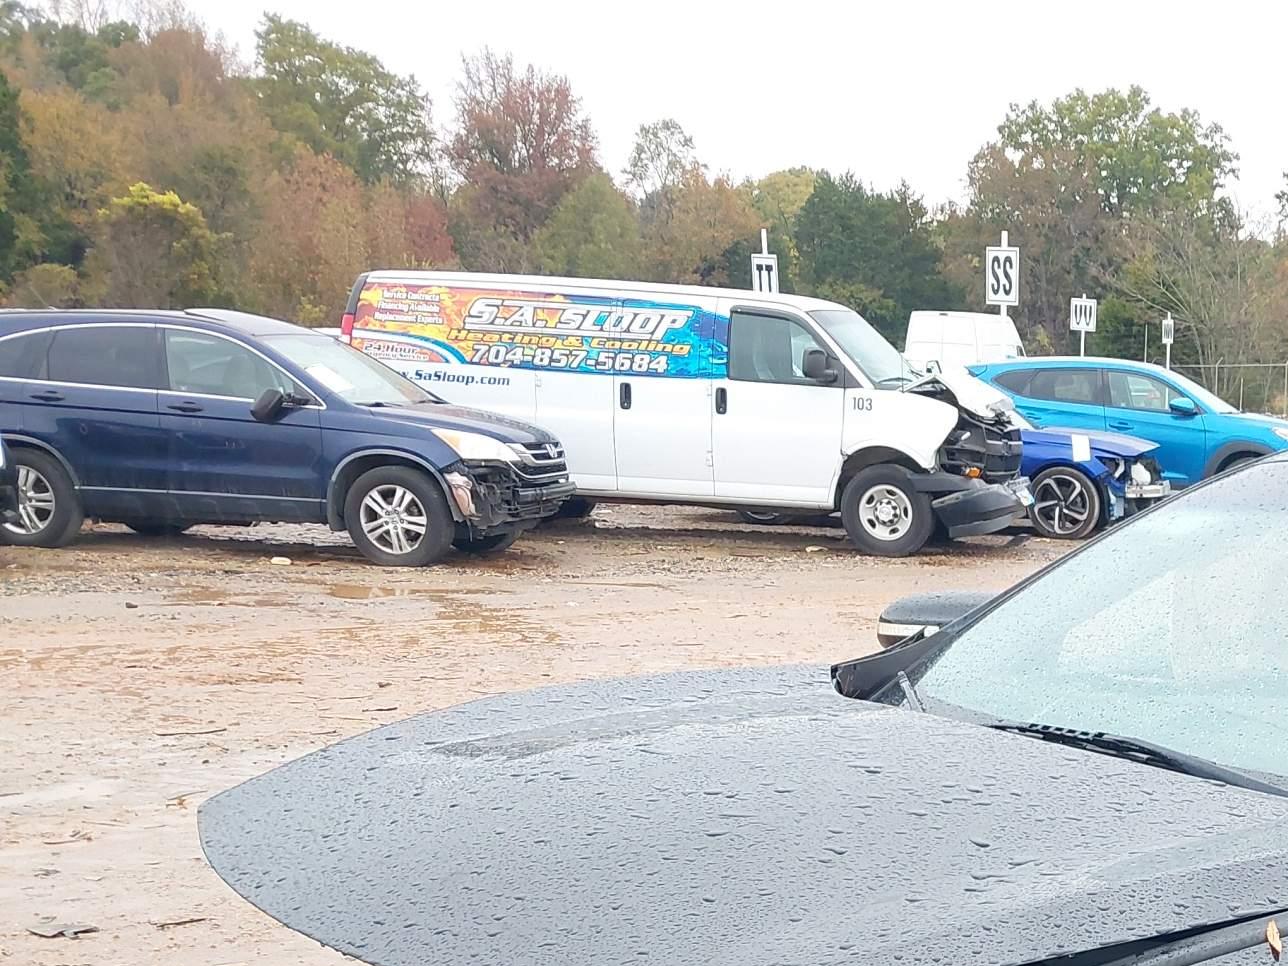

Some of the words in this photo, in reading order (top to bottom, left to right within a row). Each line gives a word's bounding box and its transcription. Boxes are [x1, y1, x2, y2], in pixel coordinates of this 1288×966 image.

[991, 255, 1013, 296] SS
[463, 297, 548, 329] S.A.
[447, 328, 557, 347] Heating
[562, 335, 583, 347] &
[590, 337, 692, 356] Cooling
[471, 344, 669, 373] 704-857-5684
[853, 397, 873, 411] 103
